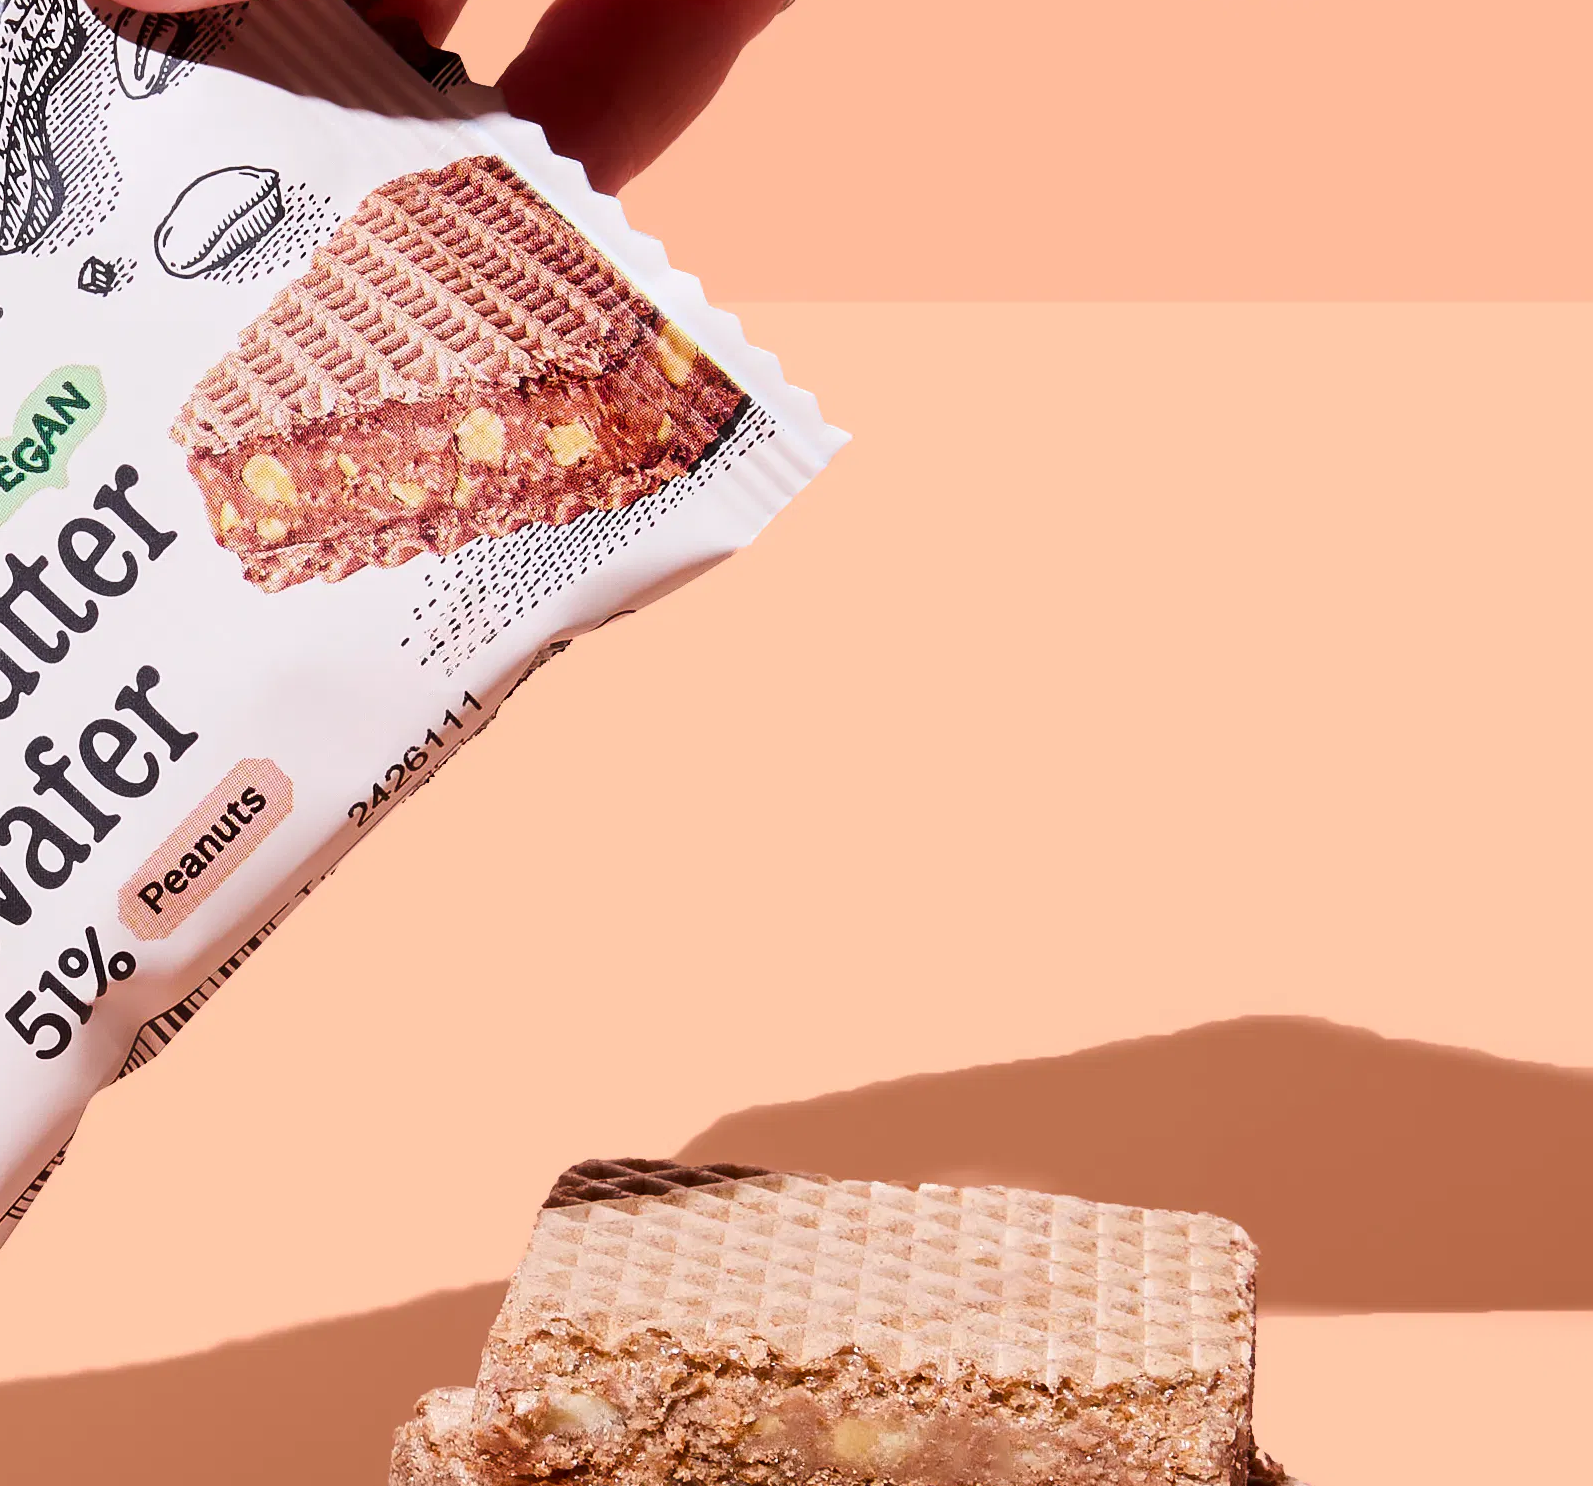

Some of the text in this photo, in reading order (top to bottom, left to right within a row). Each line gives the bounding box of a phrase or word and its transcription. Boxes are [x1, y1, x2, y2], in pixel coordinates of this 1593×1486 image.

[347, 690, 483, 828] 2426111
[5, 786, 266, 1060] 51% Peanuts
